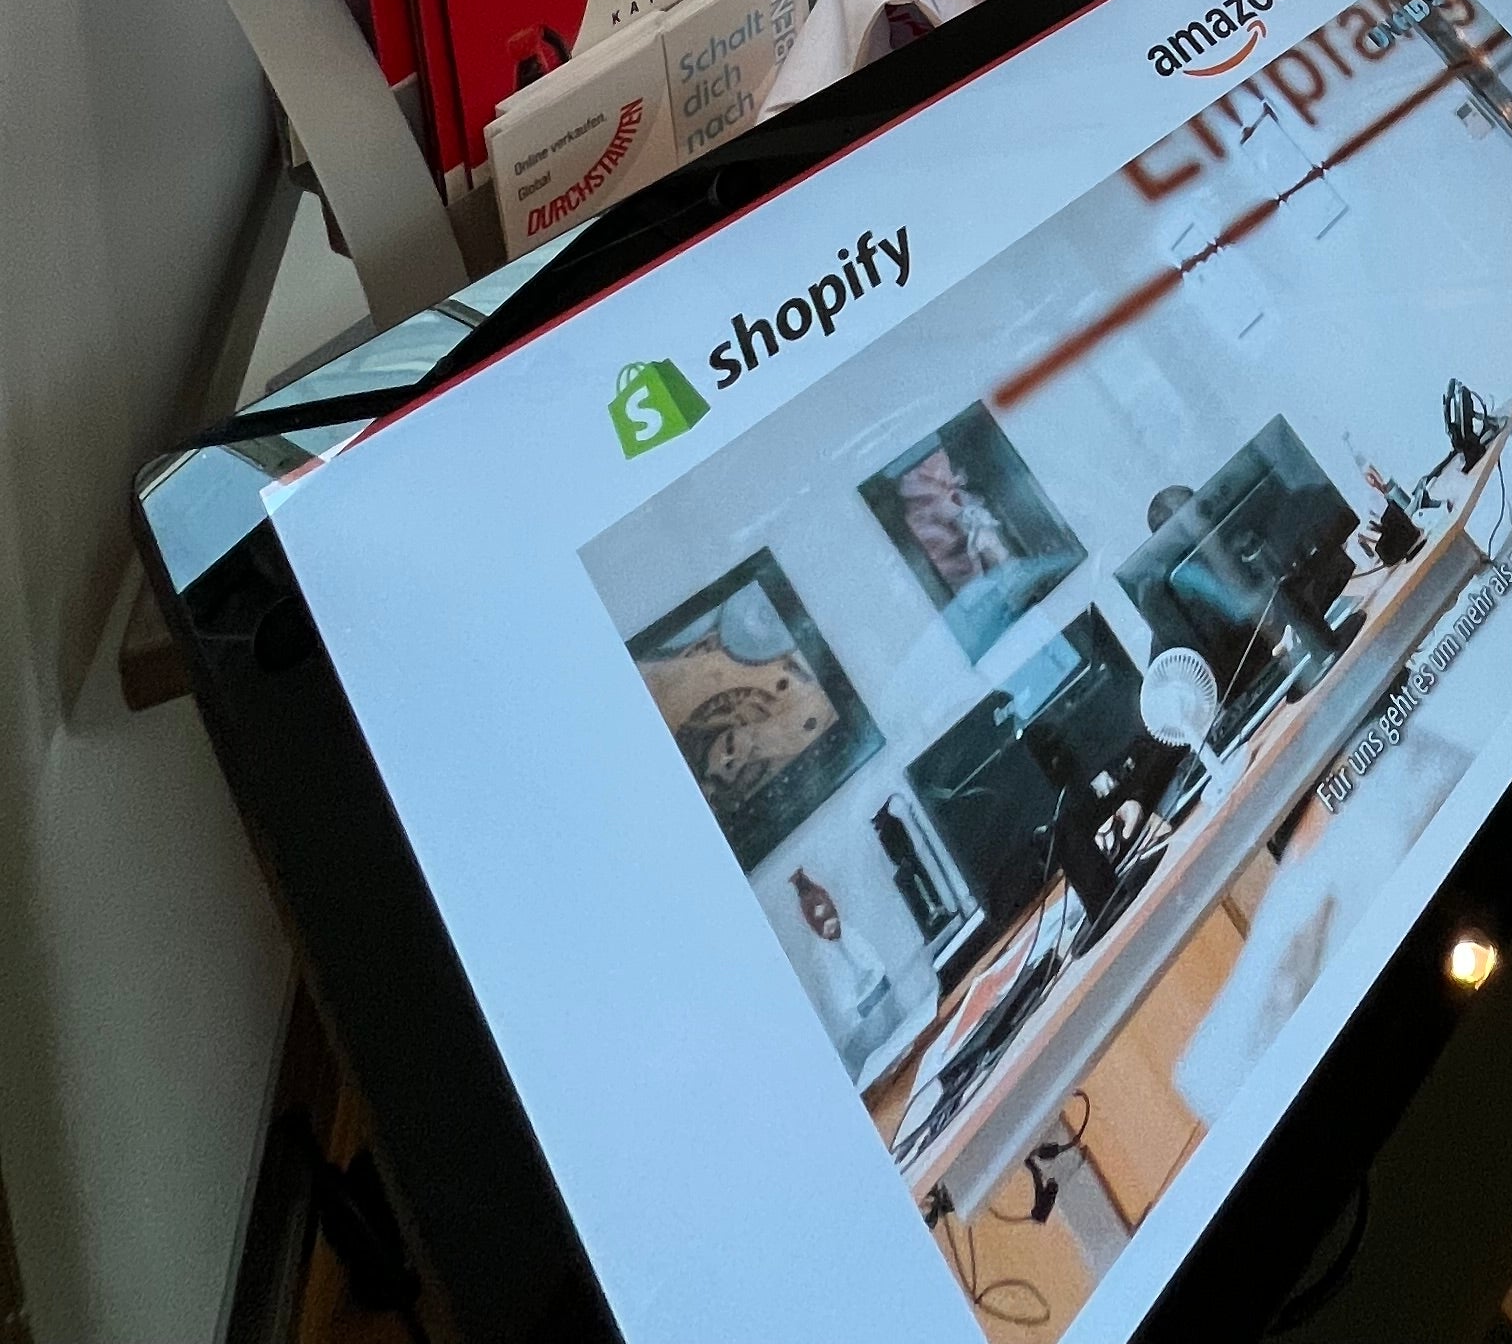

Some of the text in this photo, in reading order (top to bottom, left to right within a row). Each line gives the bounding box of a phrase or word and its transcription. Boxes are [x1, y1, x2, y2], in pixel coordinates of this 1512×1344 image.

[679, 9, 765, 84] Schalt
[684, 63, 741, 117] dich
[687, 90, 755, 154] nach
[514, 146, 549, 176] Online
[518, 171, 552, 202] Global
[527, 97, 644, 237] DURCHSTARTEN
[708, 225, 911, 391] shopify
[1315, 769, 1353, 812] Für
[1348, 731, 1384, 776] uns
[1379, 686, 1420, 744] geht
[1411, 665, 1437, 693] es
[1428, 634, 1460, 671] um
[1453, 587, 1494, 642] mehr
